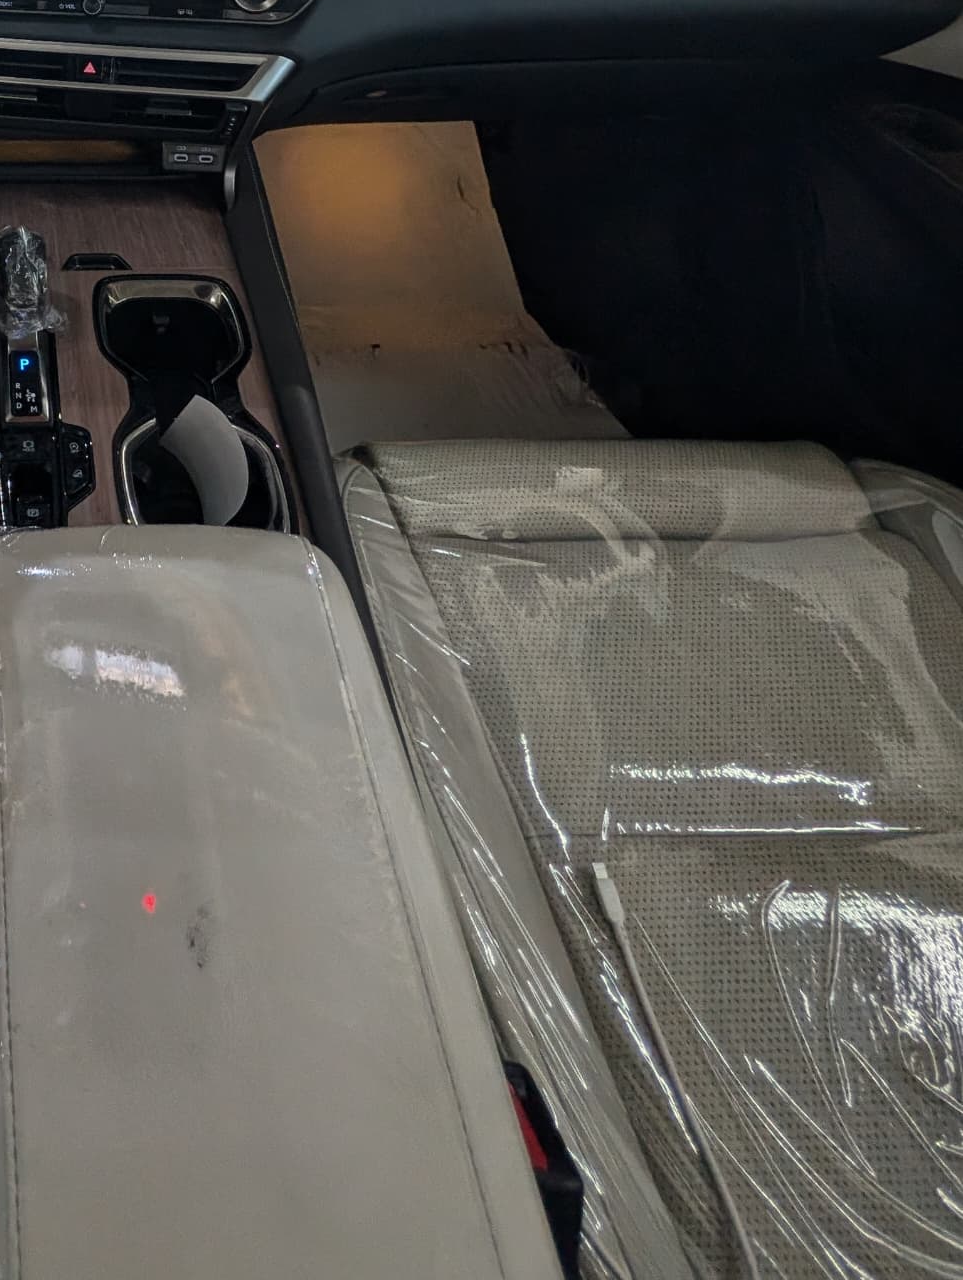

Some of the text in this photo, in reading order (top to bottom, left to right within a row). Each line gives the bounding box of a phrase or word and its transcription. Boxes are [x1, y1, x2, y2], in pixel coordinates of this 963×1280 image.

[19, 358, 29, 370] P
[15, 382, 21, 390] R
[15, 391, 22, 400] N
[30, 405, 38, 413] M
